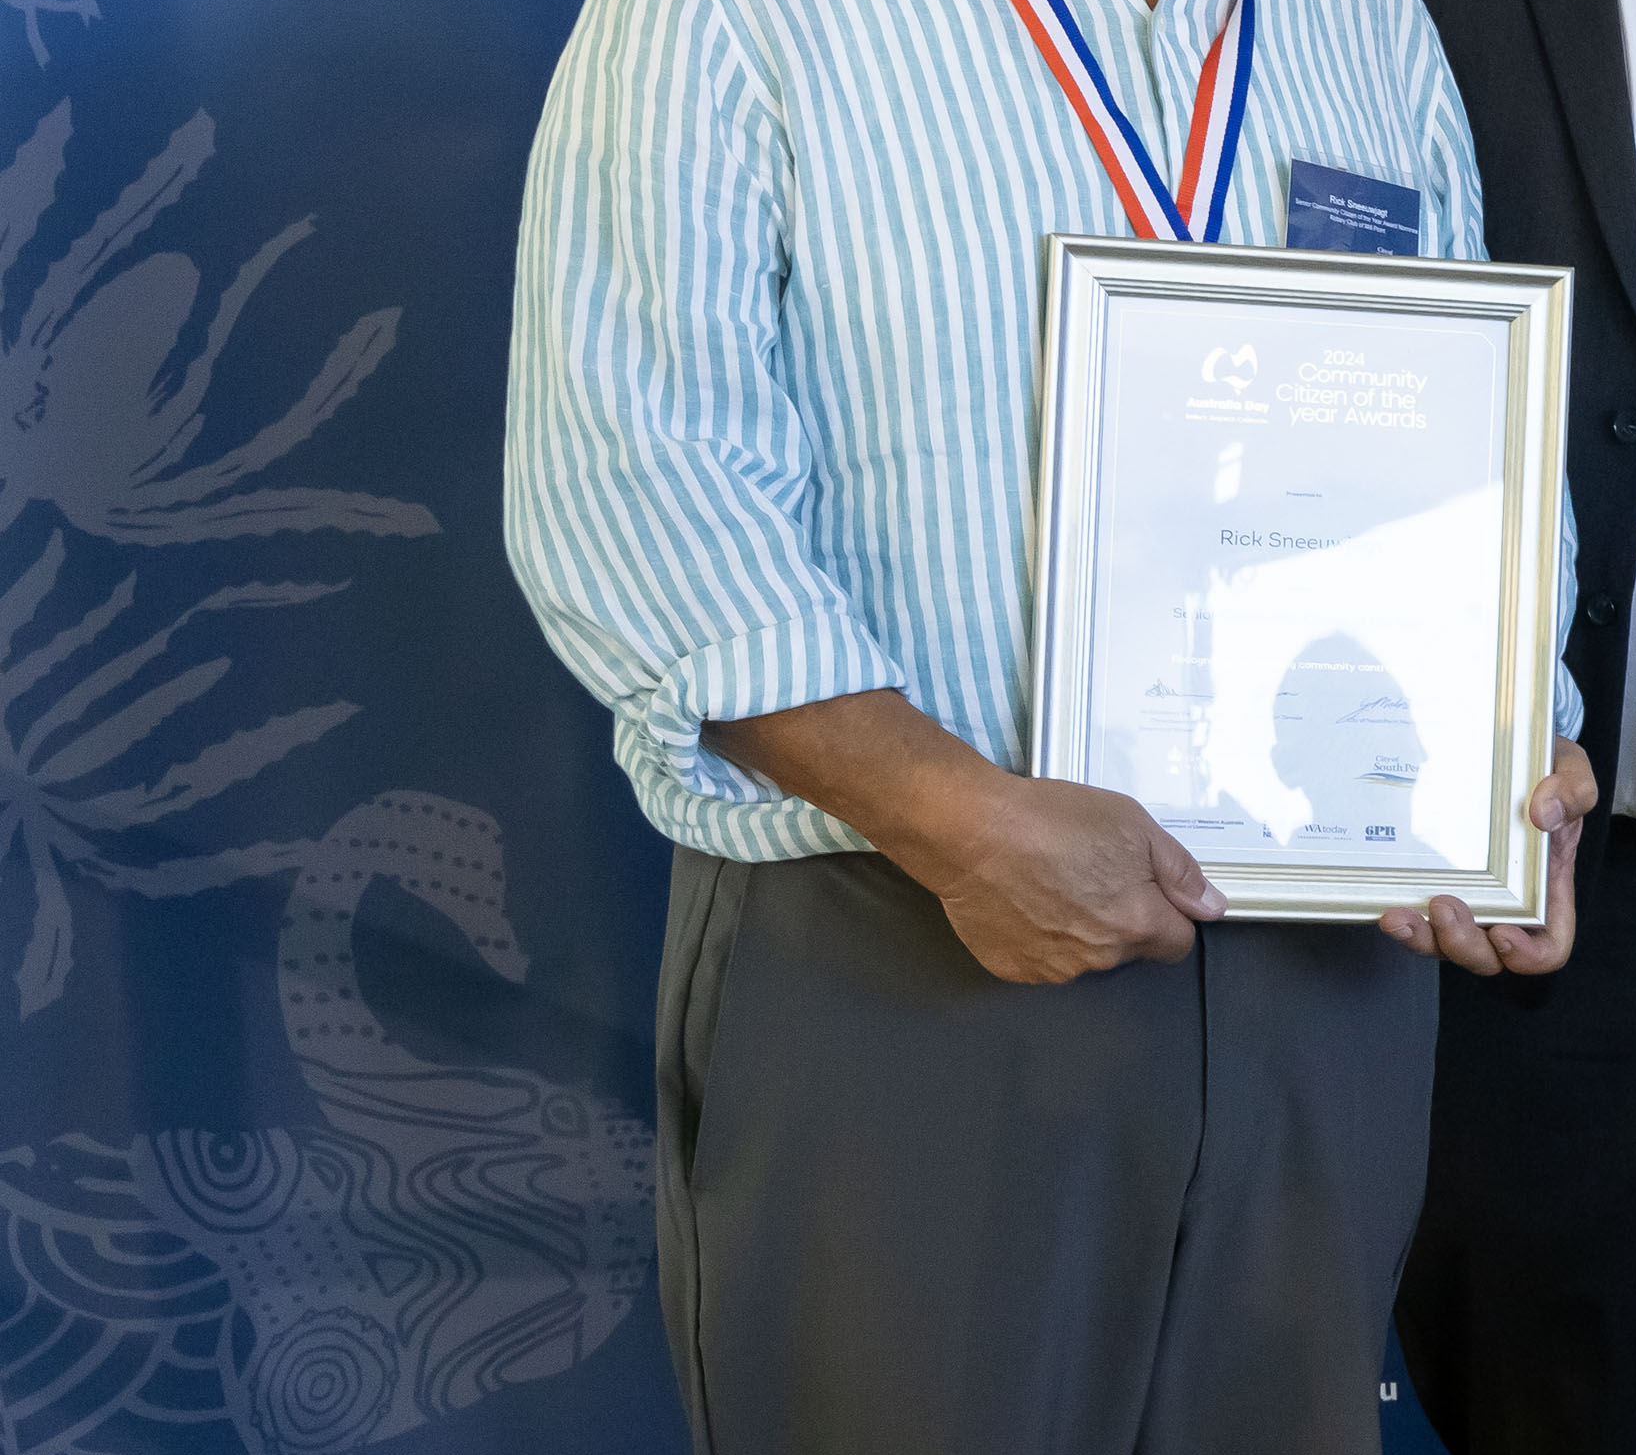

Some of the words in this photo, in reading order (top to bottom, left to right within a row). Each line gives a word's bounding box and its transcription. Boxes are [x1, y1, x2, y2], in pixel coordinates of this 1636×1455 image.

[1329, 195, 1345, 205] Rick
[1324, 349, 1365, 366] 2024
[1299, 363, 1428, 393] Community
[1186, 397, 1242, 410] Australia
[1244, 400, 1270, 413] Day
[1276, 384, 1347, 405] Citizen
[1353, 389, 1377, 407] of
[1381, 389, 1416, 409] the
[1289, 406, 1338, 426] year
[1344, 407, 1427, 429] Awards
[1221, 529, 1263, 547] Rick
[1374, 762, 1403, 772] South
[1365, 825, 1396, 836] 6PR
